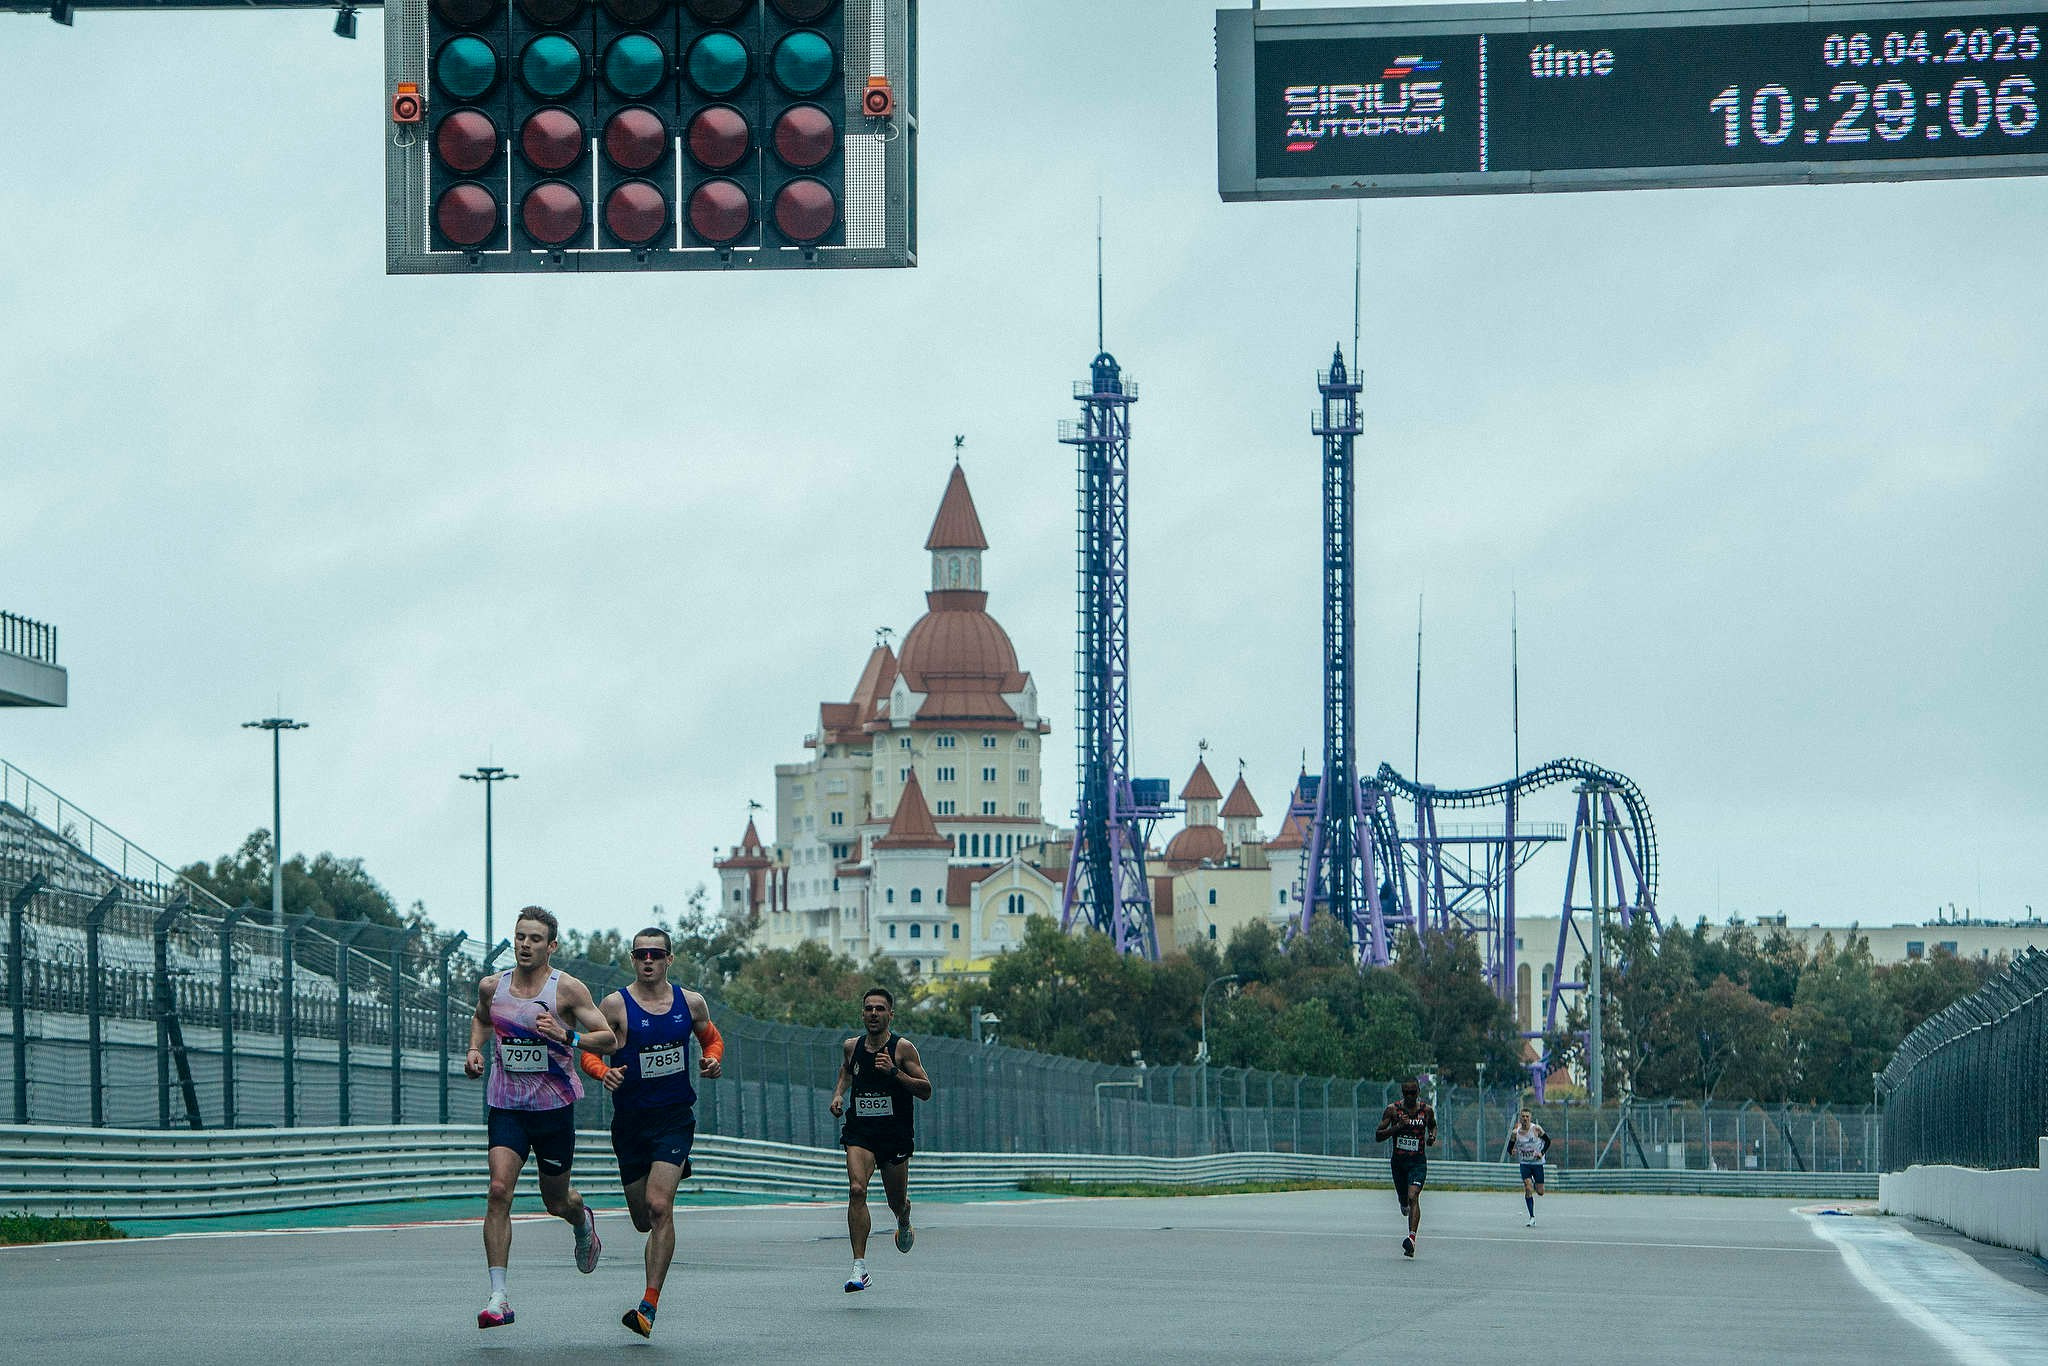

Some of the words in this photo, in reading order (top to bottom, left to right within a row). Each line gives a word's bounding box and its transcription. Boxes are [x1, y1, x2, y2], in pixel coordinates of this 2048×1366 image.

[1823, 25, 2042, 68] 06.04.2025
[1529, 43, 1616, 78] time
[1284, 82, 1445, 116] SIRIUS
[1709, 74, 2040, 147] 10:29:06
[1286, 116, 1445, 137] AUTODROM
[506, 1049, 542, 1062] 7970
[645, 1051, 680, 1068] 7853
[860, 1100, 888, 1109] 6362
